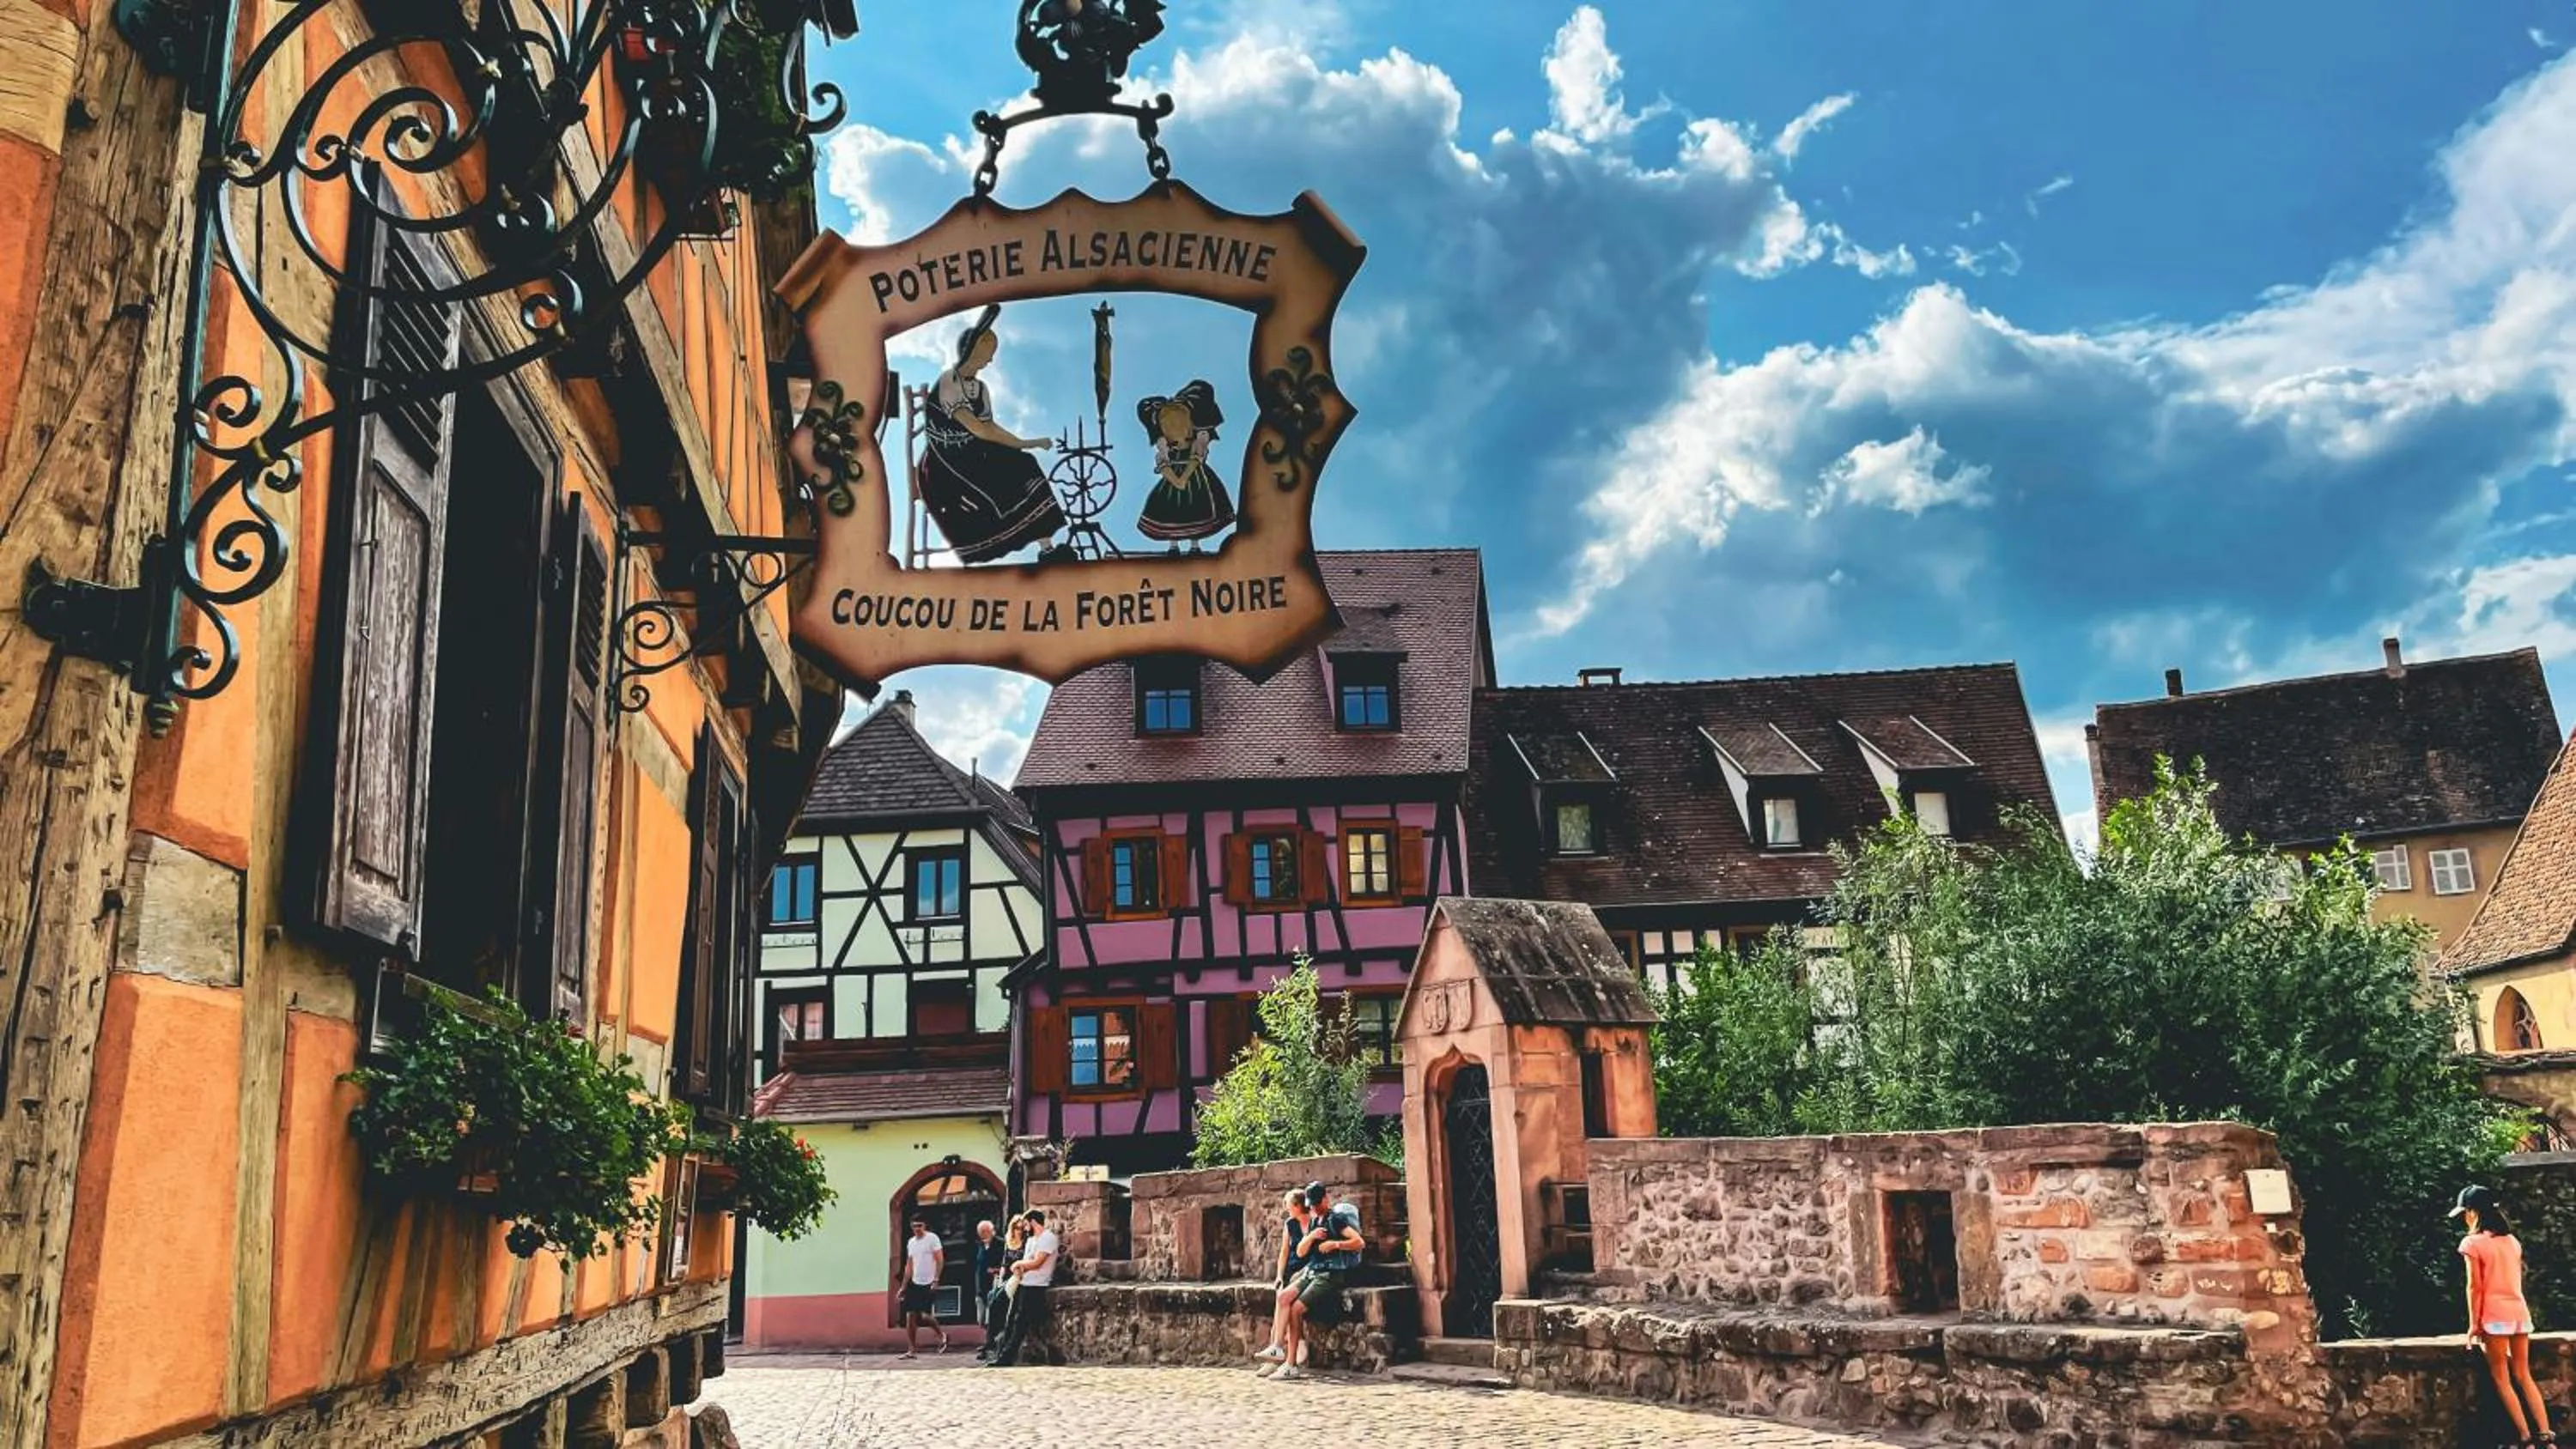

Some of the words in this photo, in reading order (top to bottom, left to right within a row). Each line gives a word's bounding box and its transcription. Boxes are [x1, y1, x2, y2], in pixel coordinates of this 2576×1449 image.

[869, 240, 1025, 313] POTERIE
[1041, 230, 1277, 283] ALSACIENNE
[832, 588, 955, 629] COUCOU
[969, 598, 1007, 631] DE
[1023, 600, 1060, 632] LA
[1076, 578, 1175, 630] FORÊT
[1190, 575, 1288, 617] NOIRE
